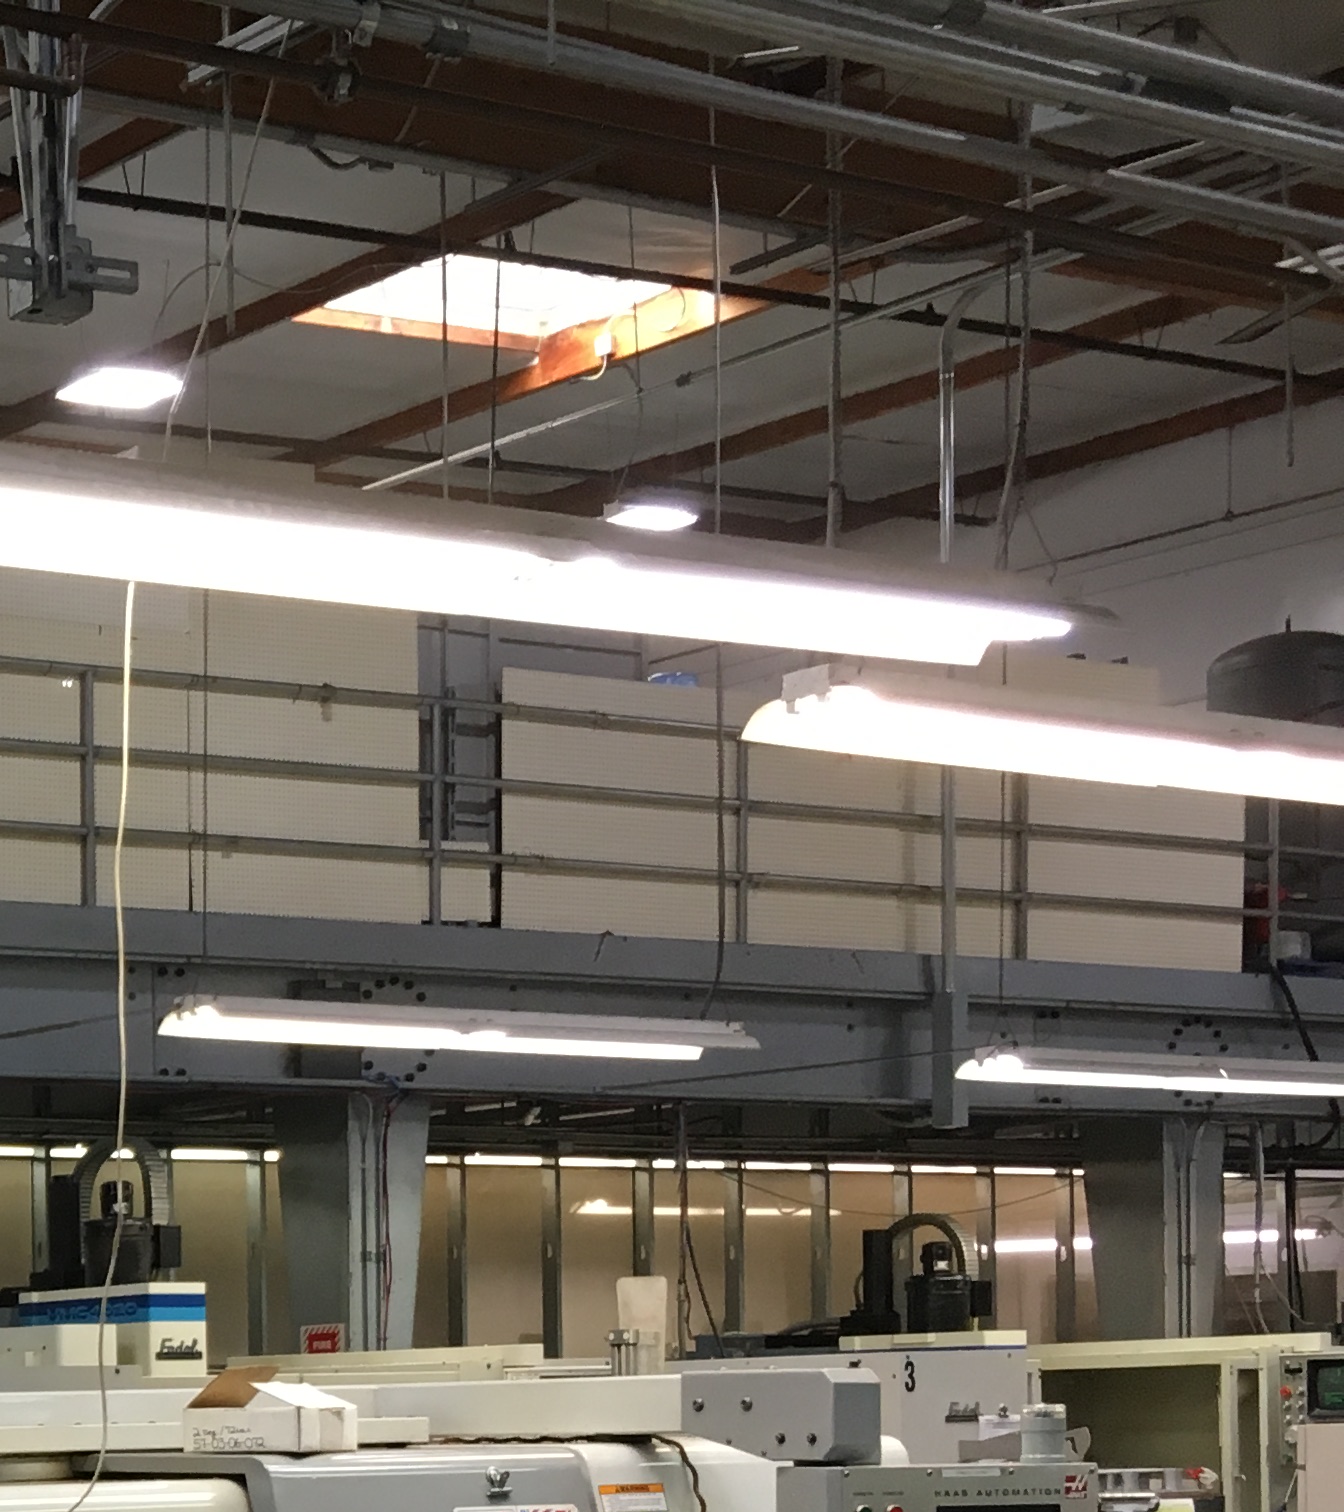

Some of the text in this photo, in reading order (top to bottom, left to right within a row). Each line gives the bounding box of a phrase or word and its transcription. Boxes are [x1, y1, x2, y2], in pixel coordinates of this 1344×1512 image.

[904, 1360, 916, 1392] 3
[934, 1488, 1062, 1498] HAAS AUTOMATION
